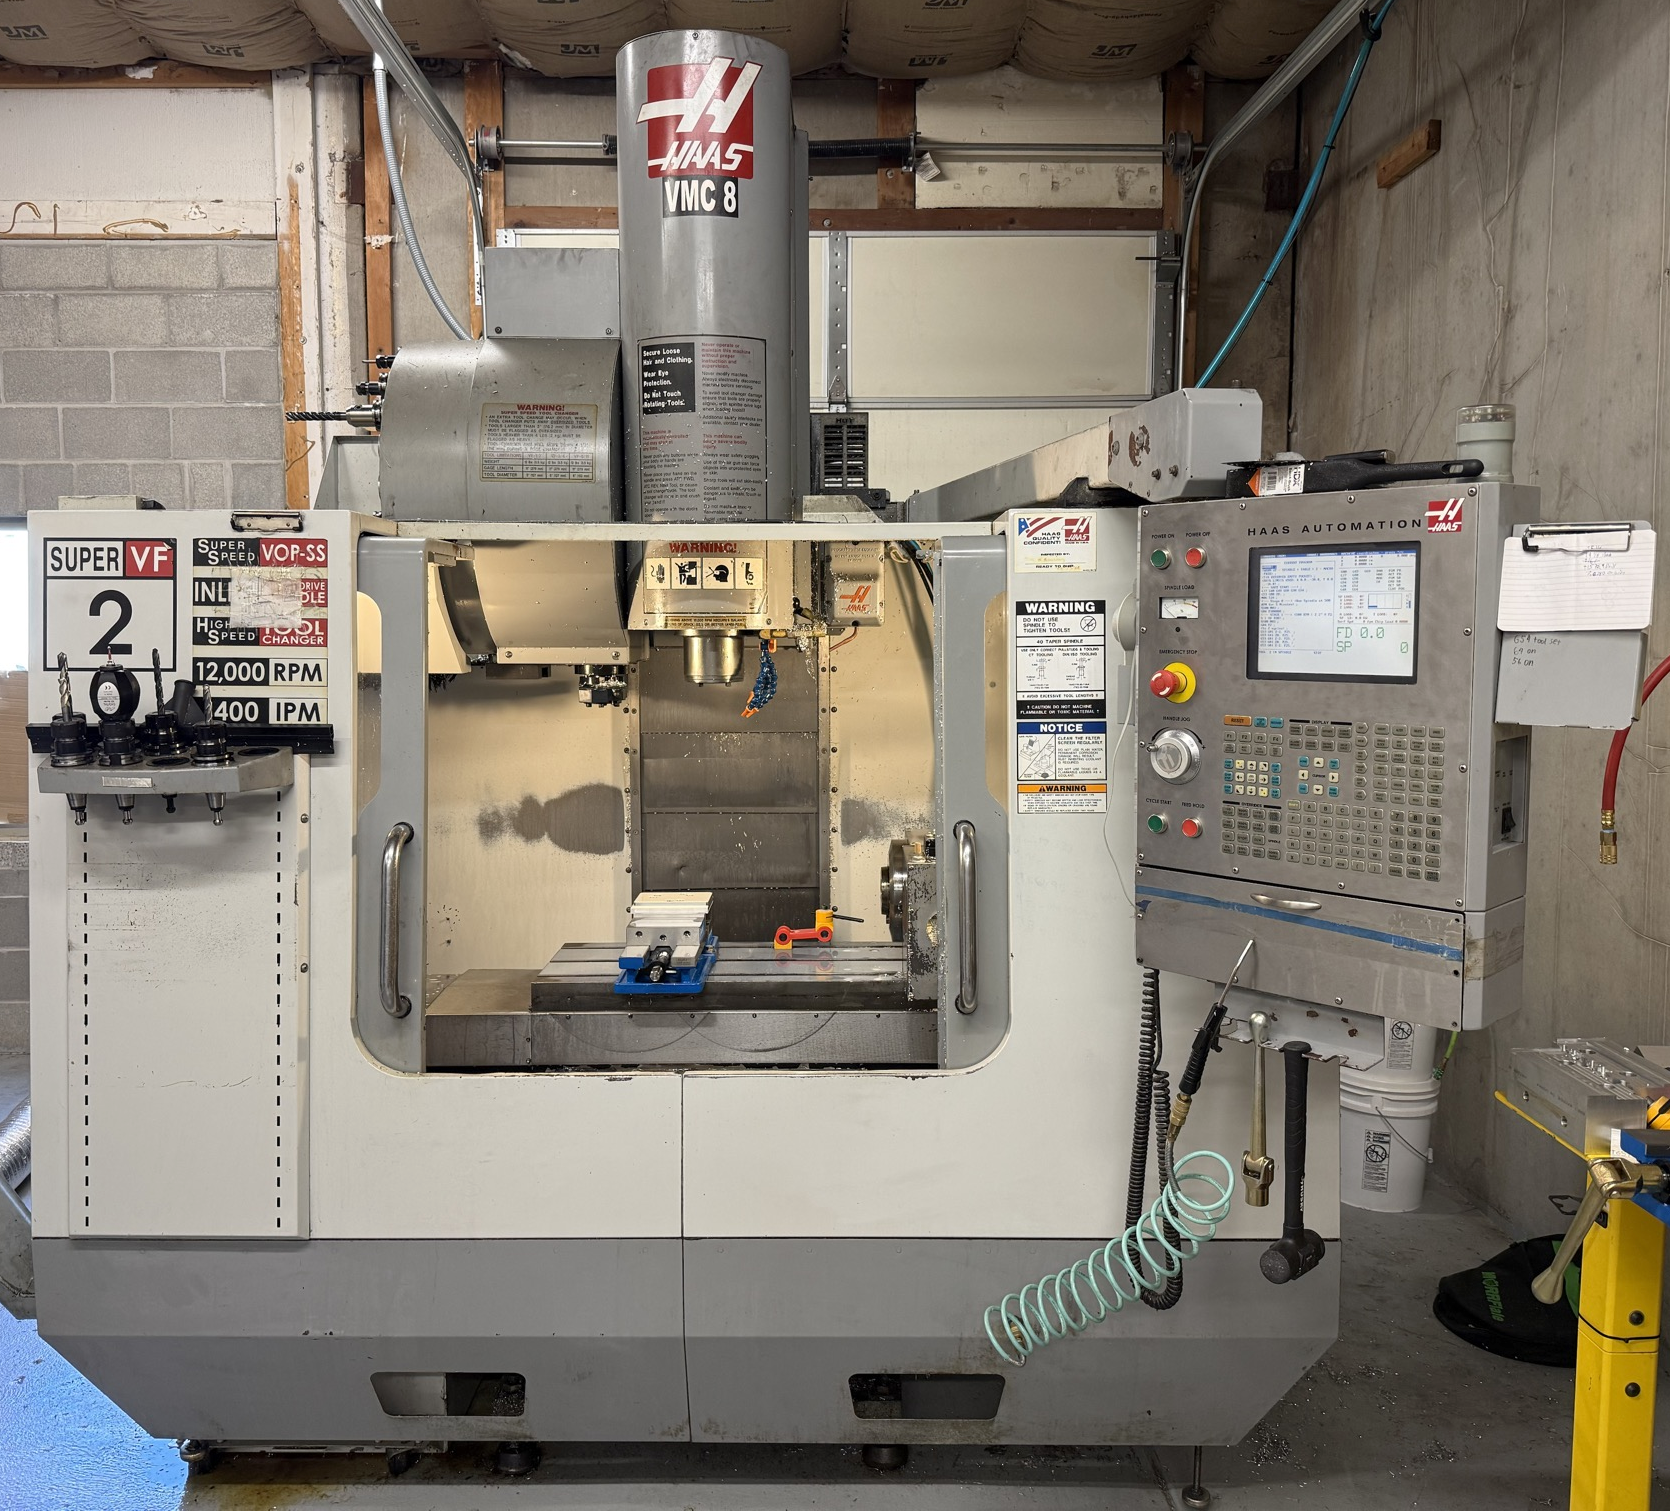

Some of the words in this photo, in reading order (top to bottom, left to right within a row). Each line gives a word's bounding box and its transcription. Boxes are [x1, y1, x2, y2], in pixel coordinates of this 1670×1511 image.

[648, 141, 754, 171] HAAS
[664, 180, 716, 212] VMC
[724, 181, 736, 213] 8
[1248, 526, 1290, 536] HAAS
[1301, 519, 1422, 533] AUTOMATION
[1428, 522, 1462, 532] HAAS
[198, 539, 245, 553] SUPER
[262, 544, 326, 561] VOP-SS
[669, 543, 737, 553] WARNING!
[50, 546, 120, 572] SUPER
[130, 546, 168, 572] VF
[208, 551, 255, 565] SPEED
[1025, 602, 1095, 613] WARNING
[89, 589, 132, 655] 2
[208, 630, 255, 644] SPEED
[1337, 627, 1352, 638] FD
[1360, 627, 1384, 638] 0.0
[262, 635, 324, 645] CHANGER
[1337, 641, 1352, 652] SP
[1400, 642, 1408, 653] 0
[196, 662, 265, 682] 12,000
[274, 662, 322, 682] RPM
[276, 702, 321, 722] IPM
[1040, 724, 1083, 732] NOTICE
